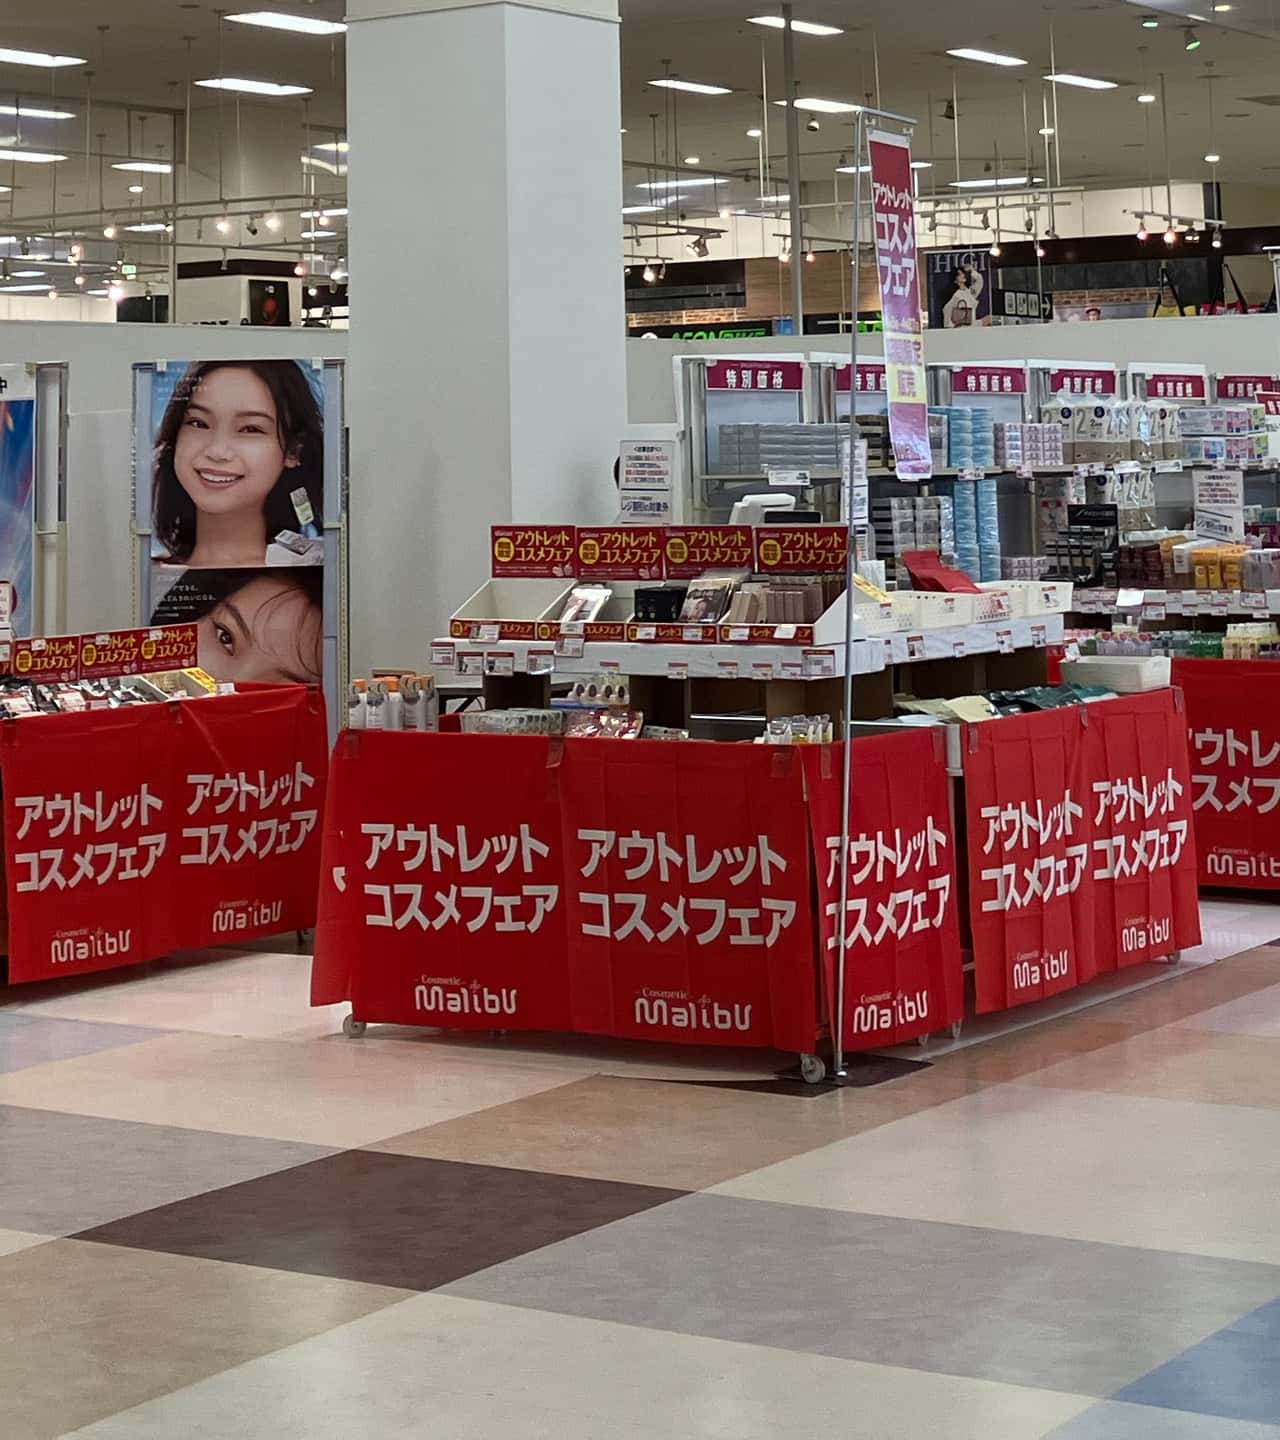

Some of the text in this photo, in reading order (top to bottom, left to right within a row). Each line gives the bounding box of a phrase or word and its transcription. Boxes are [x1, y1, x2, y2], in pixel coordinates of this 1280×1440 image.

[873, 182, 913, 210] アウトレット
[875, 213, 915, 253] コスメ
[879, 257, 915, 297] フェア
[726, 368, 783, 389] 特別価格
[967, 374, 1012, 392] 特別価格
[515, 530, 570, 546] アウトレット
[515, 547, 574, 562] コスメフェア
[600, 532, 657, 548] アウトレット
[600, 549, 661, 564] コスメフェア
[686, 531, 746, 547] アウトレット
[687, 548, 752, 562] コスメフェア
[782, 532, 843, 548] アウトレット
[783, 549, 848, 565] コスメフェア
[31, 656, 77, 671] コスメフェア
[97, 648, 139, 664] コスメフェア
[157, 642, 197, 658] コスメフェア
[187, 761, 315, 816] アウトレット
[1093, 768, 1184, 827] アウトレット
[15, 783, 163, 840] アウトレット
[981, 789, 1084, 856] アウトレット
[180, 808, 319, 867] コスメフェア
[360, 823, 550, 875] アウトレット
[577, 827, 788, 887] アウトレット
[825, 815, 947, 889] アウトレット
[1093, 818, 1188, 881] コスメフェア
[15, 831, 168, 894] コスメフェア
[981, 843, 1088, 913] コスメフェア
[363, 883, 560, 935] コスメフェア
[578, 890, 797, 949] コスメフェア
[825, 874, 951, 951] コスメフェア
